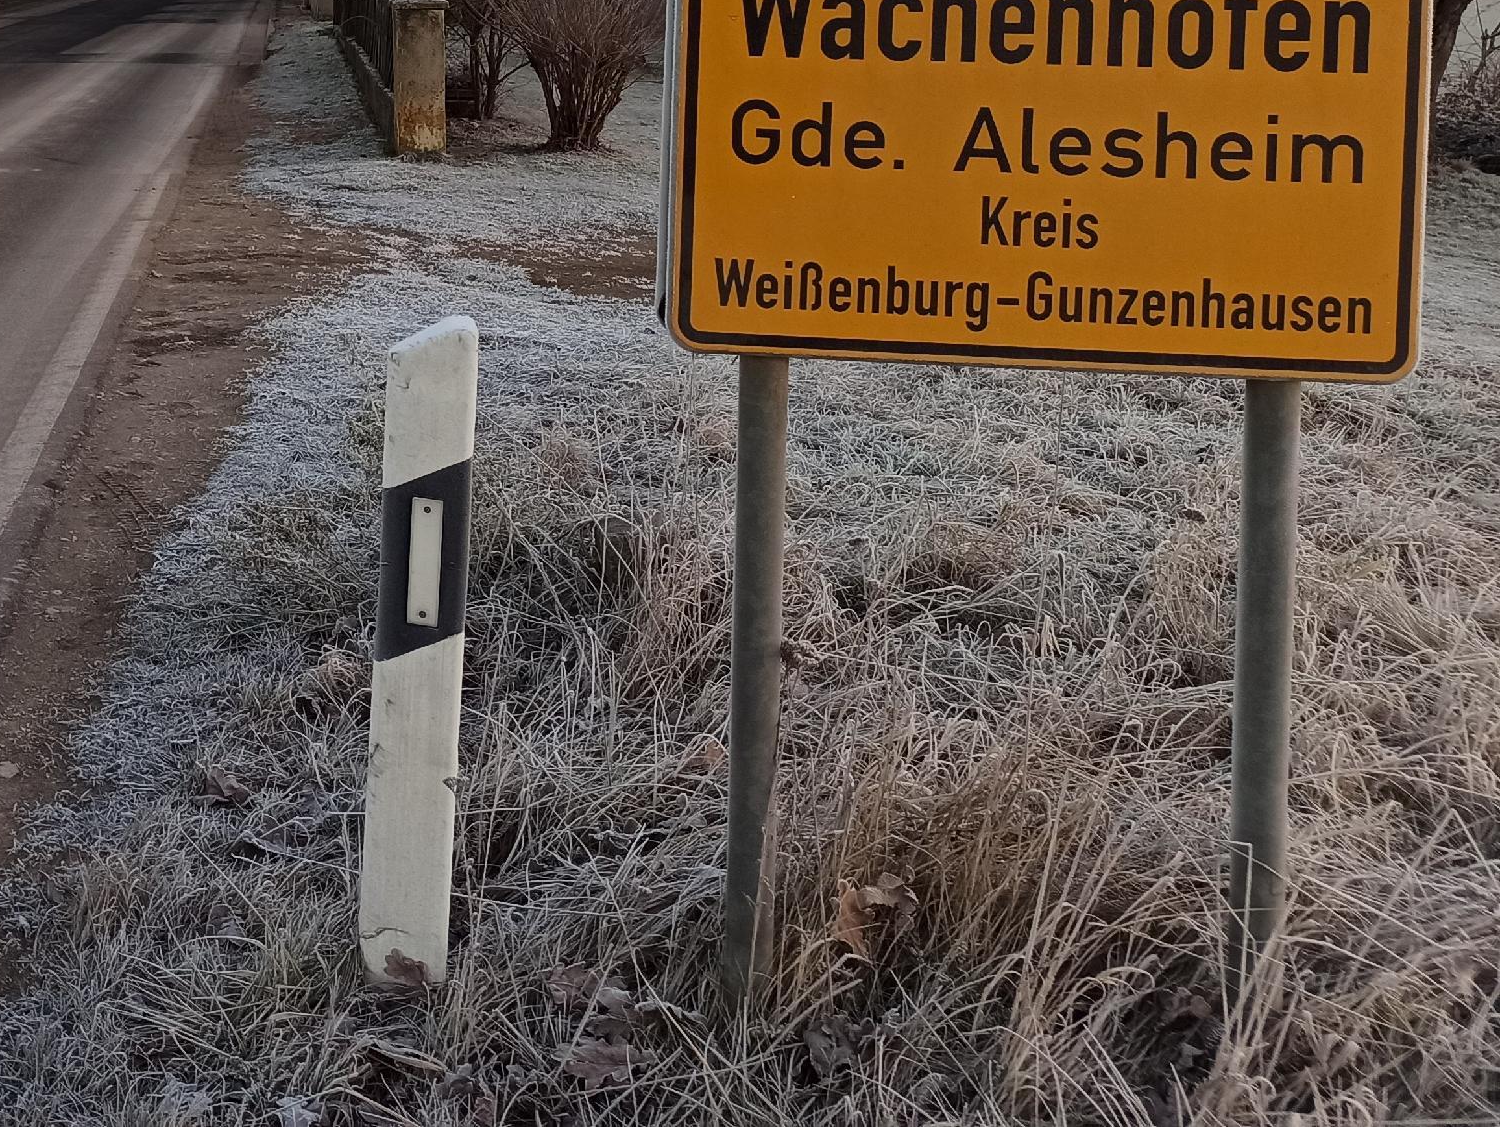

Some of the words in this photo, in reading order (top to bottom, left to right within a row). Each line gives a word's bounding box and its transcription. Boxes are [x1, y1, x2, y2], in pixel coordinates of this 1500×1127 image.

[731, 98, 905, 171] Gde.
[952, 106, 1364, 184] Alesheim
[980, 195, 1099, 250] Kreis
[714, 257, 1372, 335] Weißenburg-Gunzenhausen
